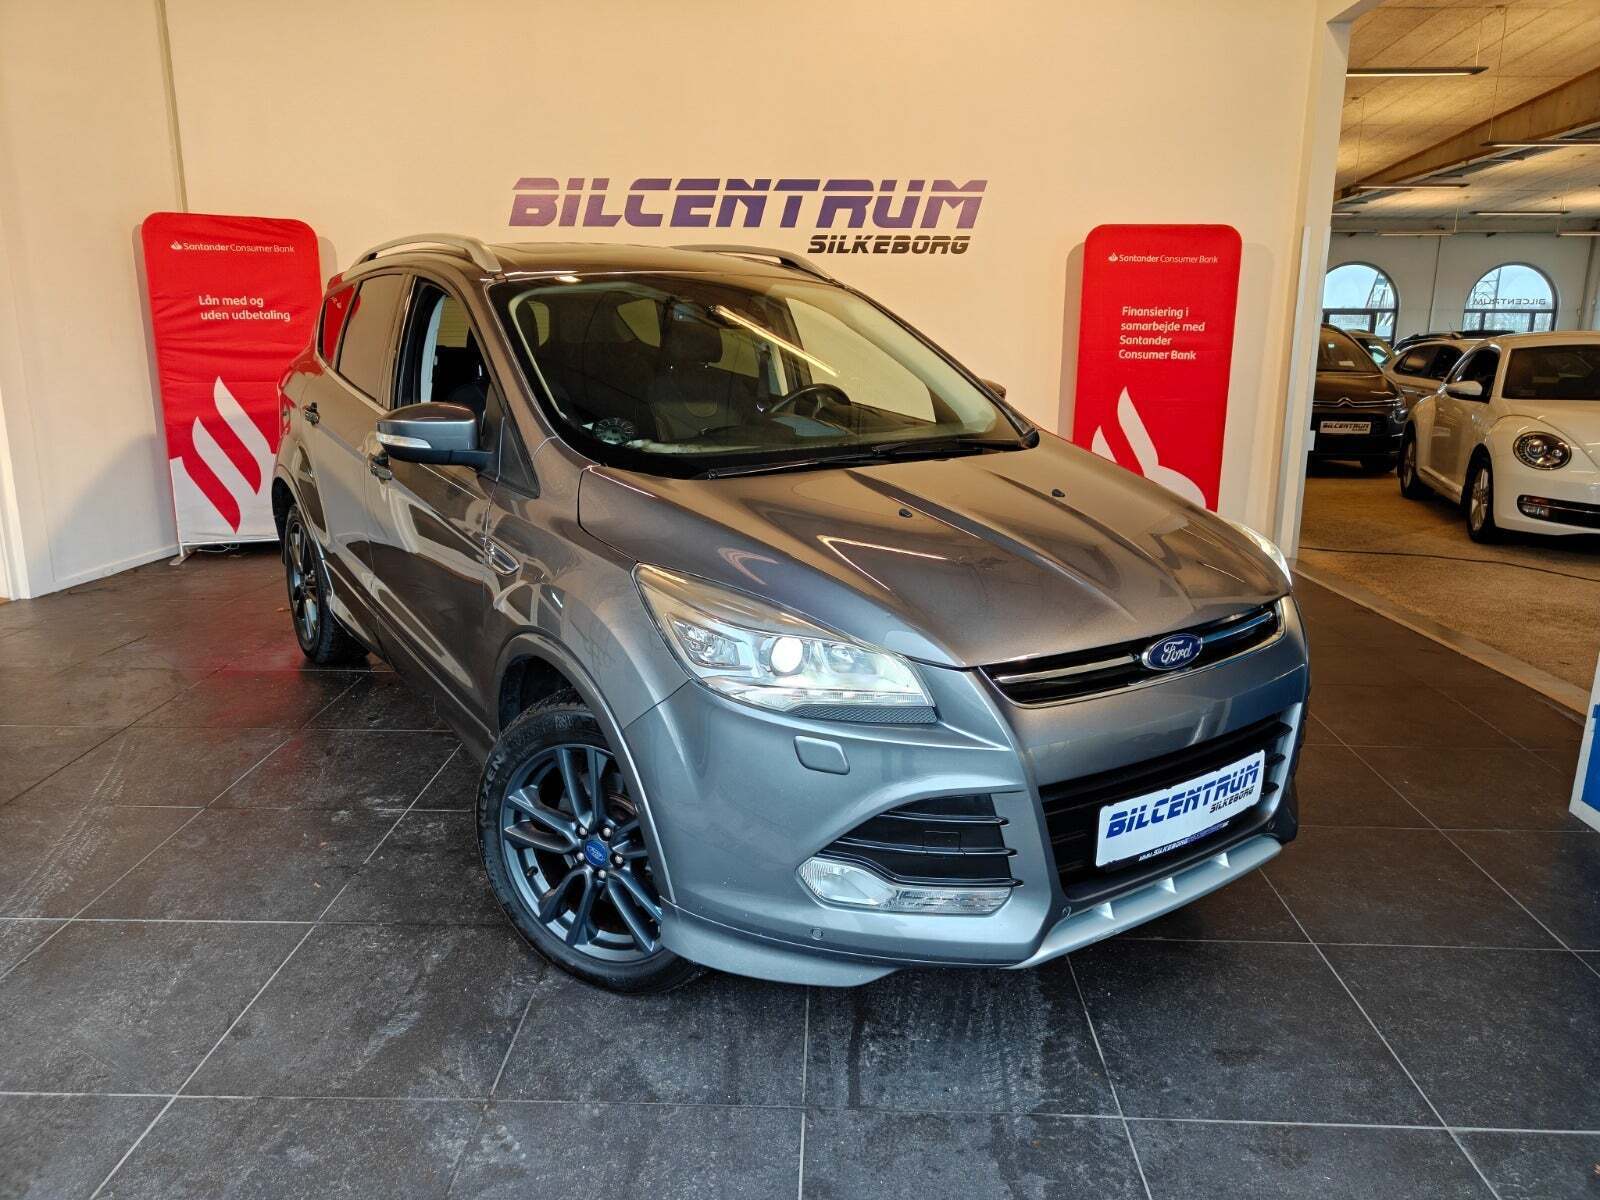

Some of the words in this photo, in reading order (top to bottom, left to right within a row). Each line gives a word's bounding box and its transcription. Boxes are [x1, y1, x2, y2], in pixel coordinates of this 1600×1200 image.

[509, 177, 988, 229] BILCENTRUM
[183, 242, 229, 252] Santander
[230, 243, 273, 253] Consumer
[274, 244, 295, 254] Bank
[807, 235, 970, 254] SILKEBORG
[1119, 254, 1159, 263] Santander
[1160, 255, 1198, 263] Consumer
[1199, 256, 1218, 264] Bank
[198, 294, 220, 306] Lån
[222, 296, 246, 306] med
[250, 299, 264, 308] og
[201, 310, 229, 320] uden
[232, 310, 291, 322] udbetaling
[1122, 306, 1184, 319] Finansiering
[1185, 307, 1189, 316] i
[1120, 322, 1180, 333] samarbejde
[1182, 322, 1205, 331] med
[1119, 335, 1172, 345] Santander
[1118, 349, 1169, 359] Consumer
[1171, 350, 1196, 360] Bank
[1161, 640, 1192, 665] Ford
[479, 753, 506, 828] NEXEN
[1106, 760, 1260, 839] BILCENTRUM
[1210, 786, 1254, 813] SILKEBORG
